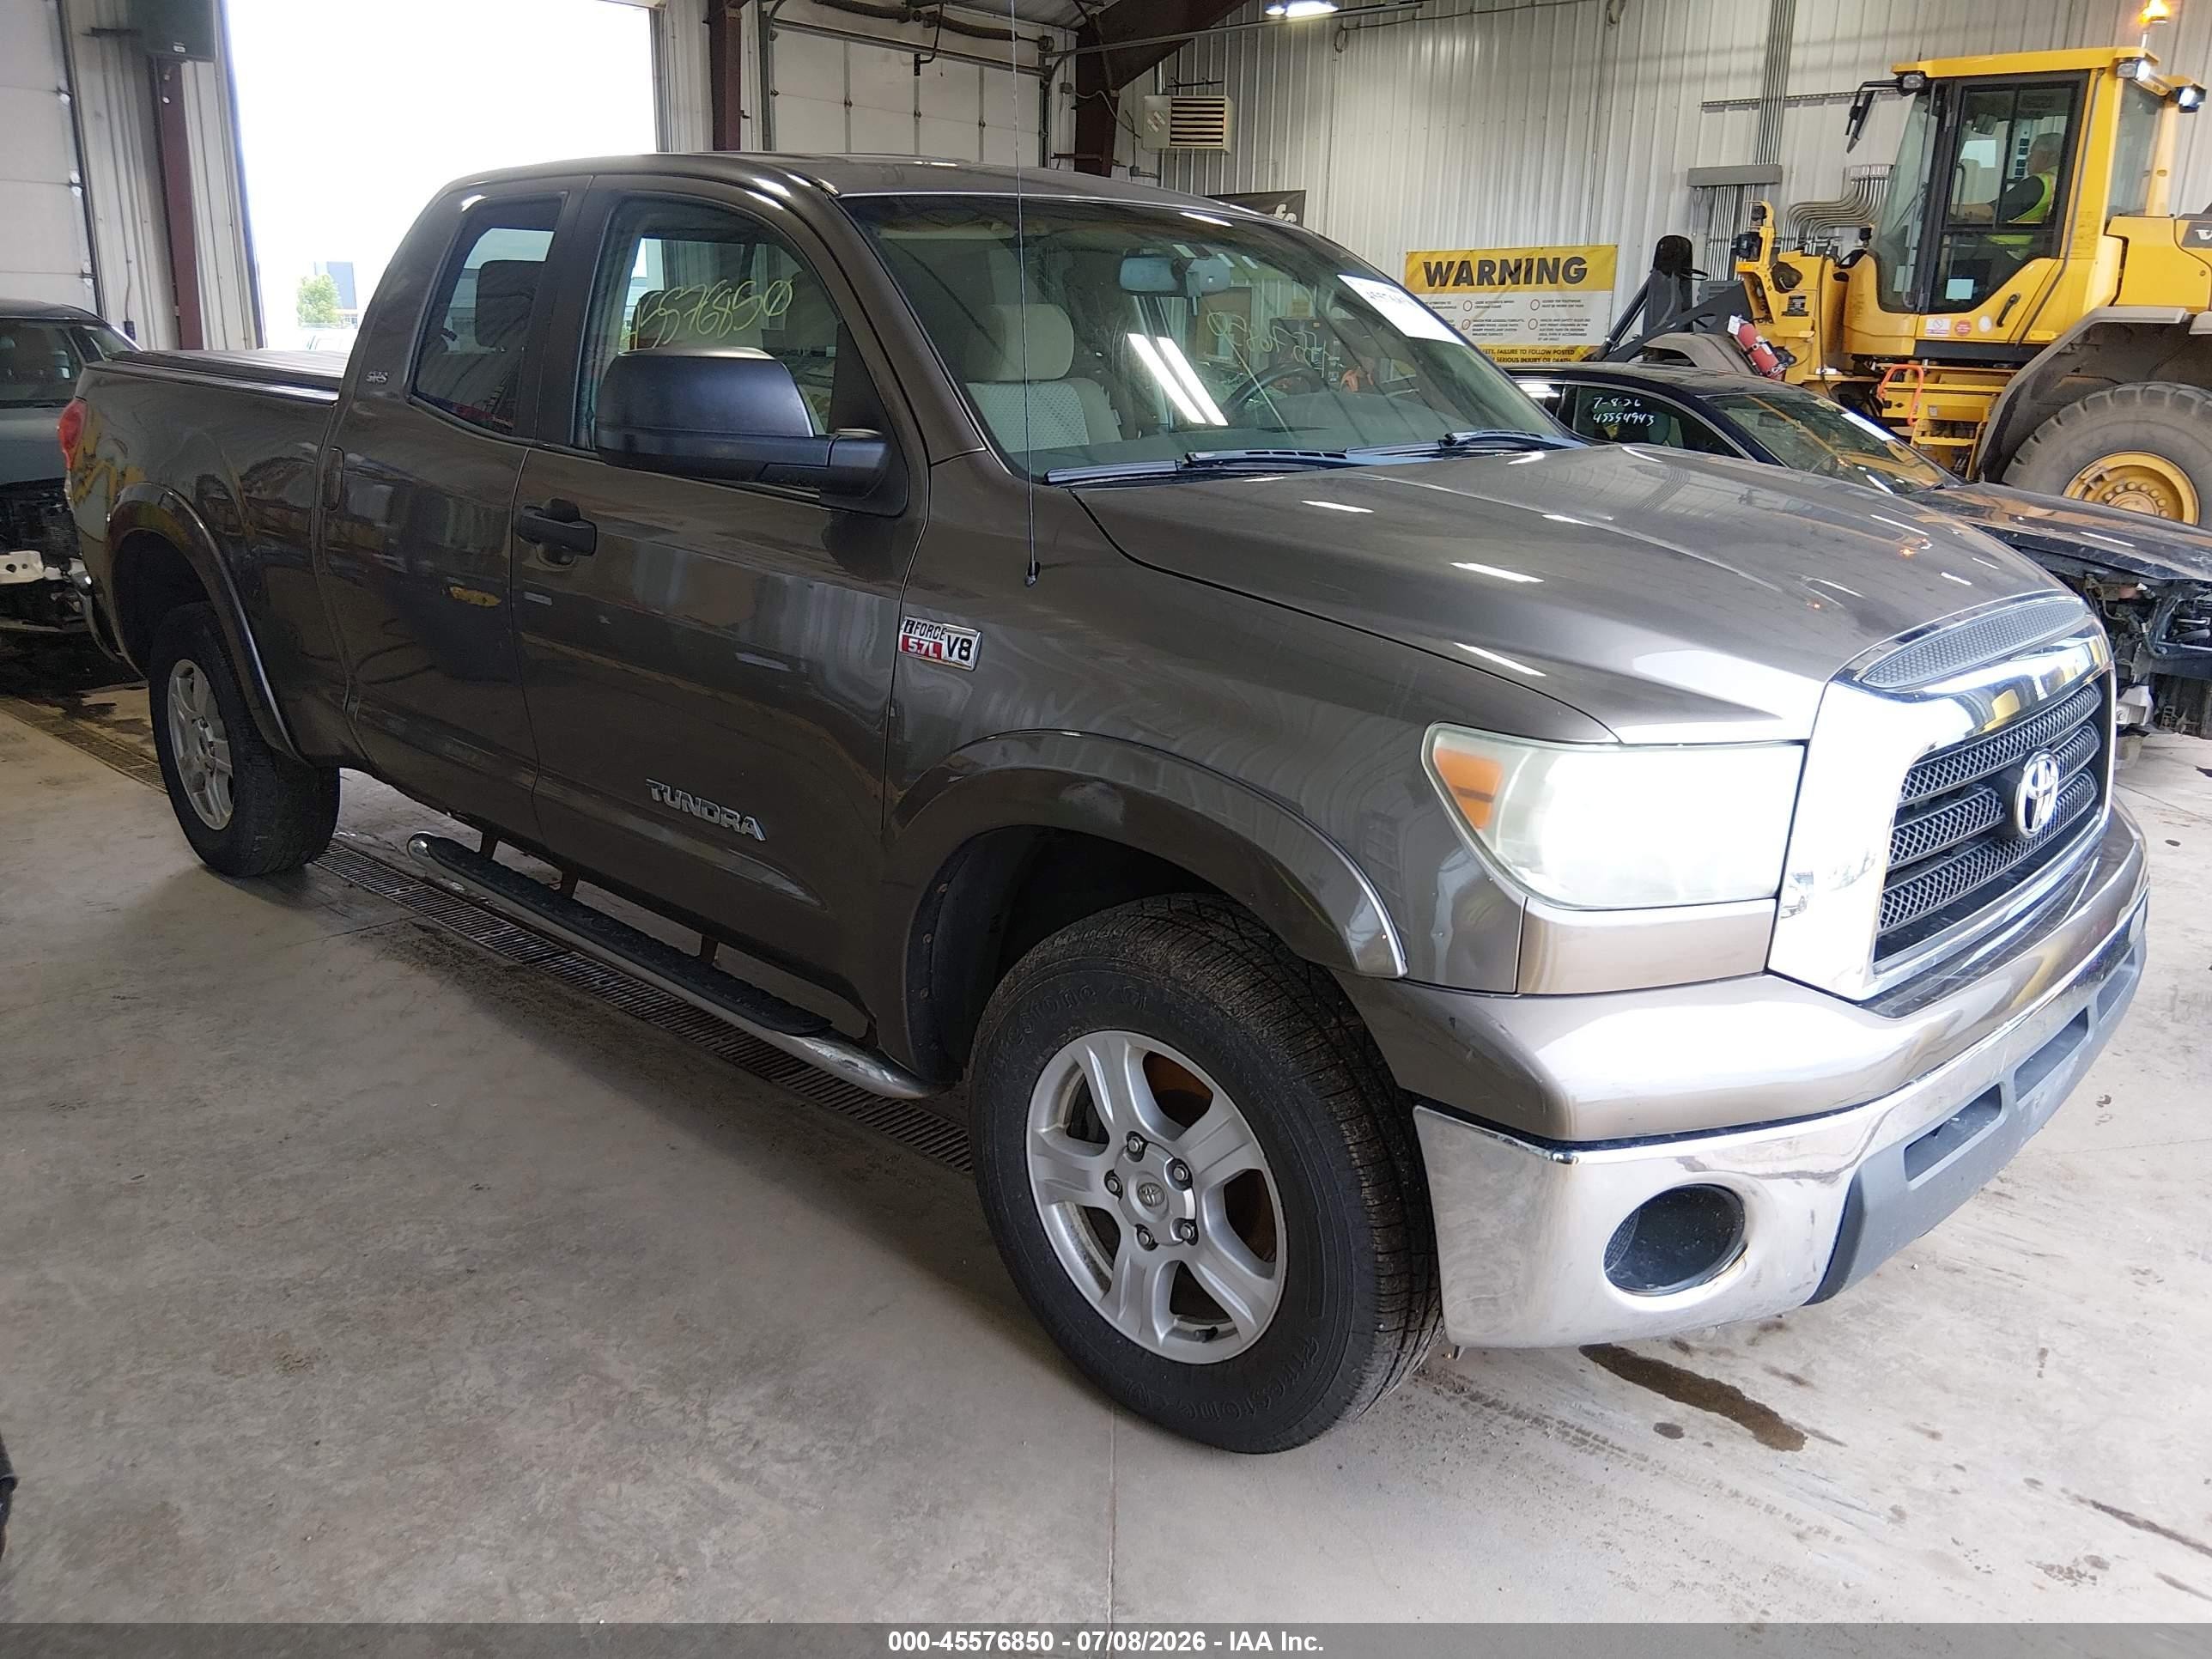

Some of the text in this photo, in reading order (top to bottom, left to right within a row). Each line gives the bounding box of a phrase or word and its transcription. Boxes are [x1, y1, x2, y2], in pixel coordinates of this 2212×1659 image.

[1423, 257, 1587, 287] WARNING
[947, 635, 972, 661] V8
[646, 778, 767, 842] TUNDRA
